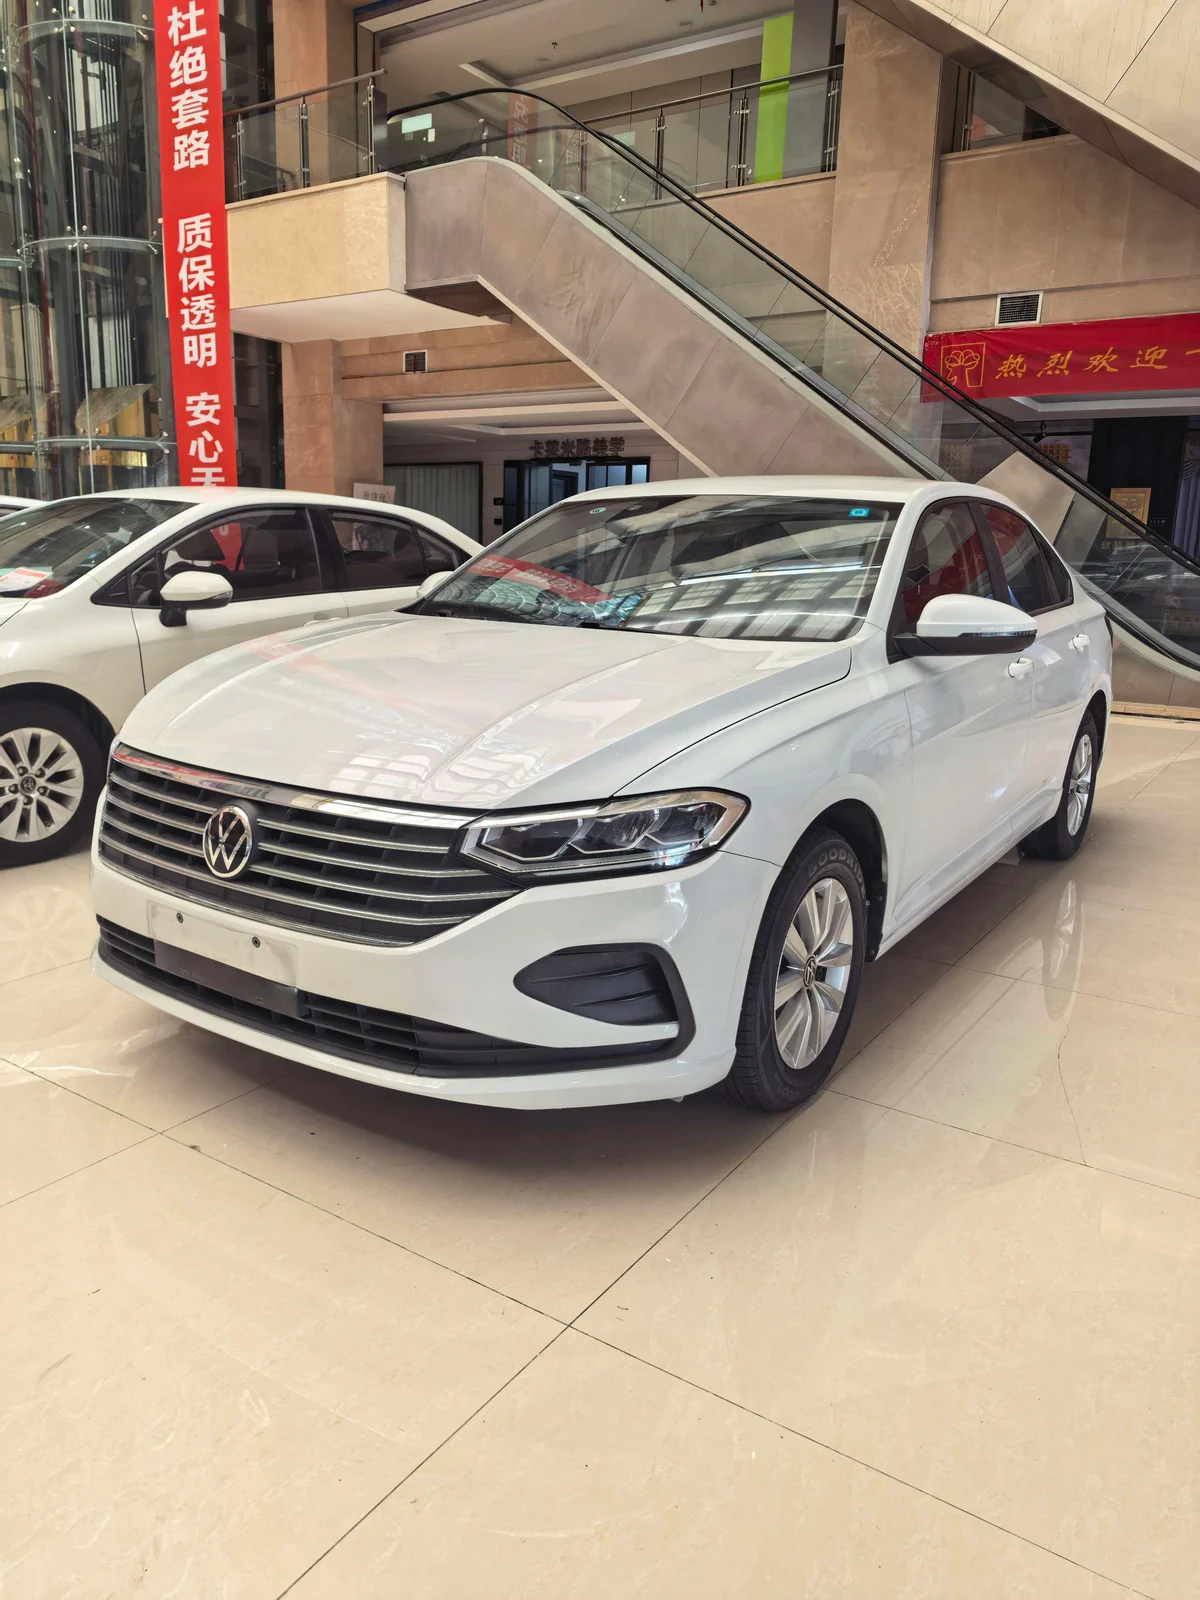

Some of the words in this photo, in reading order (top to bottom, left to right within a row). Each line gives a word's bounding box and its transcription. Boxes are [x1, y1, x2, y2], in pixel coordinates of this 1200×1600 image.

[167, 0, 208, 171] 杜绝套路
[177, 212, 216, 368] 质保透明
